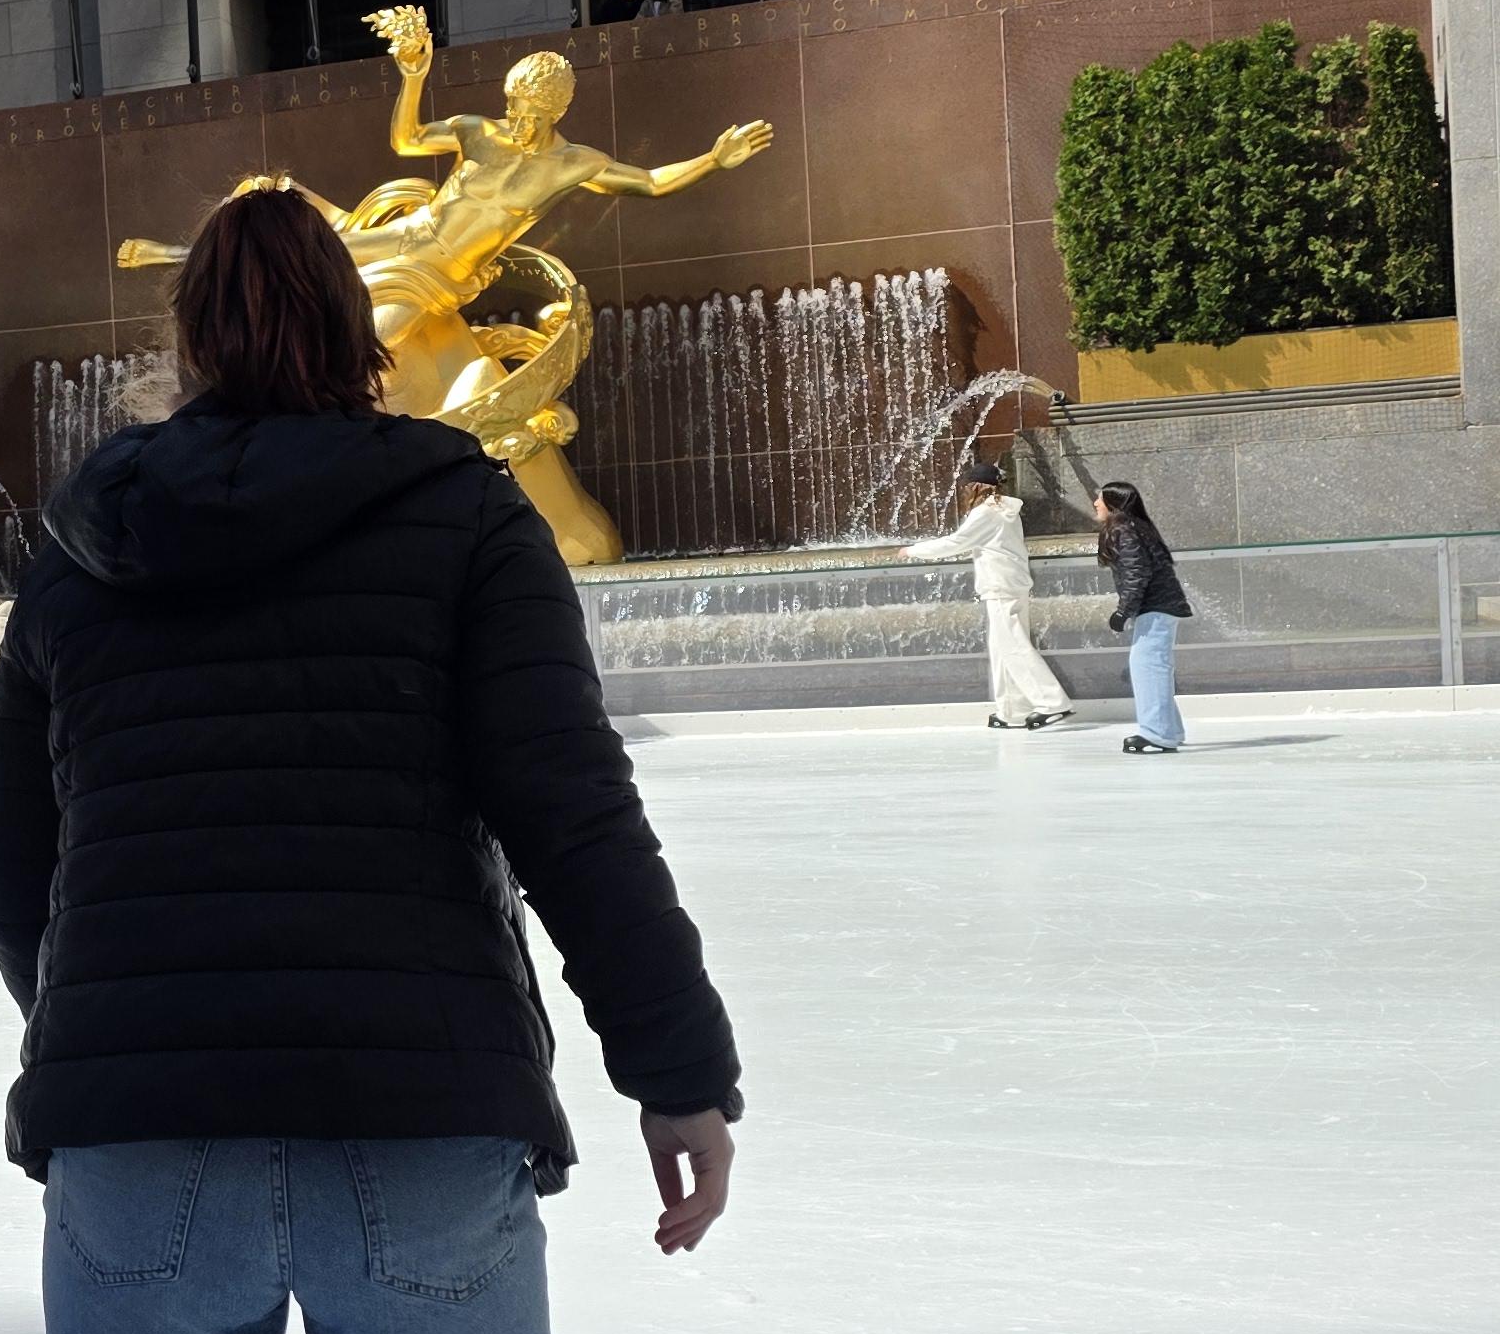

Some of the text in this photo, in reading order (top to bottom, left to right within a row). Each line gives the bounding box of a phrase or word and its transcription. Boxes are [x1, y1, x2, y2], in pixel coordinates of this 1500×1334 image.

[10, 114, 156, 144] PROVED
[204, 102, 244, 118] TO
[289, 69, 482, 107] MORTLS
[598, 32, 742, 63] MEANS
[800, 19, 846, 36] TO
[63, 85, 241, 119] TEACHER
[292, 71, 330, 93] IN
[380, 46, 513, 76] EERY
[565, 26, 640, 49] ART
